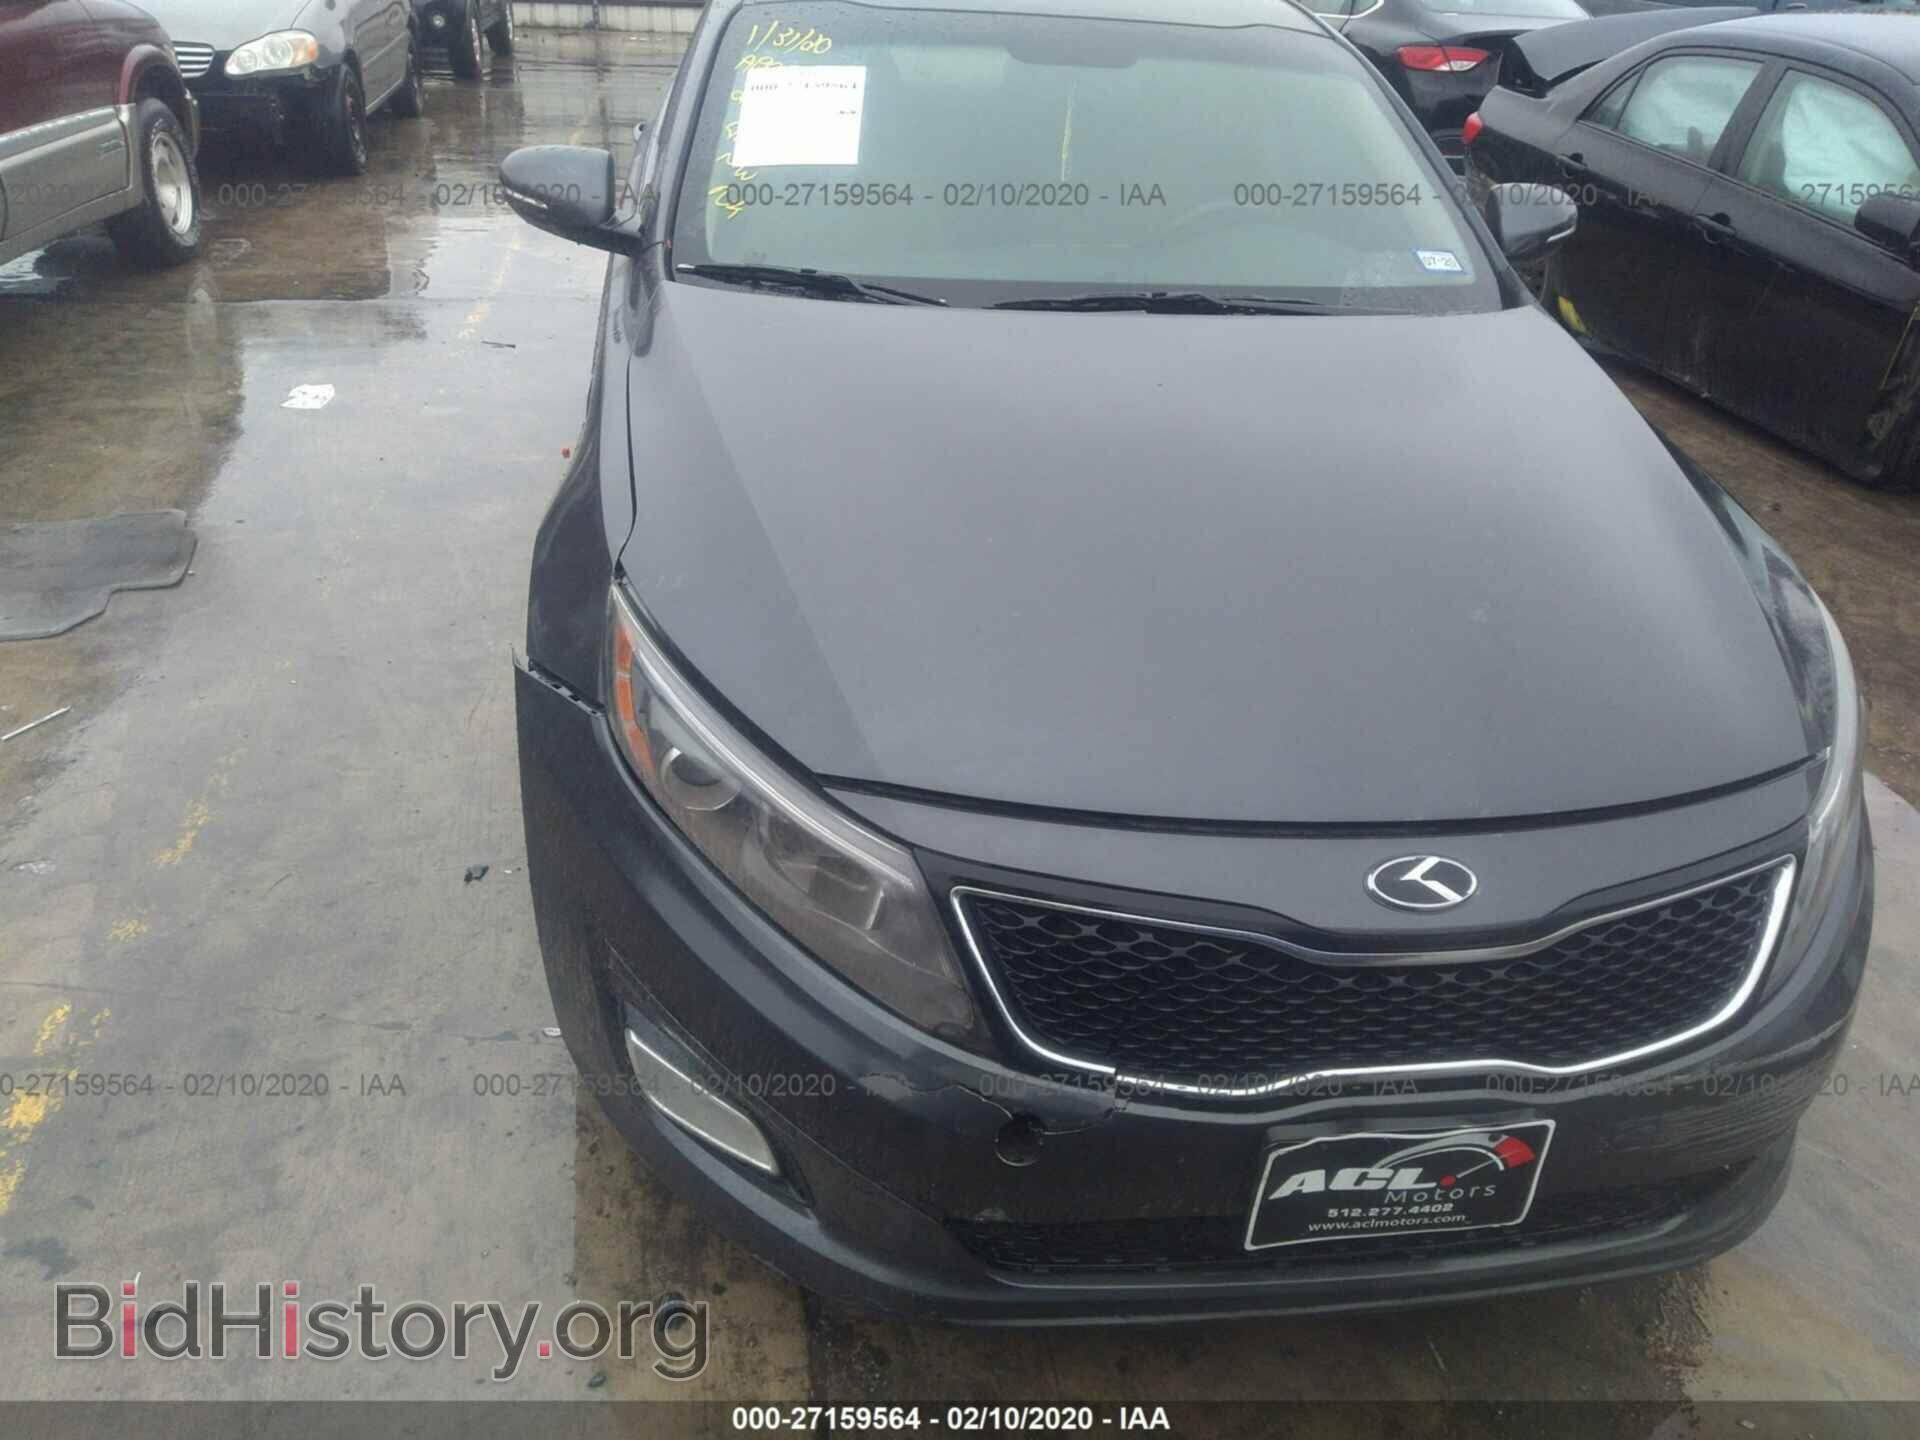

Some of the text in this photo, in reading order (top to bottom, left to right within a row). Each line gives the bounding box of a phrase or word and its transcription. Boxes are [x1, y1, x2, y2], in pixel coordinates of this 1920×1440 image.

[1384, 1184, 1497, 1204] Motors
[1327, 1203, 1454, 1219] 512.277.4402
[1308, 1213, 1466, 1232] www.aclmotors.com
